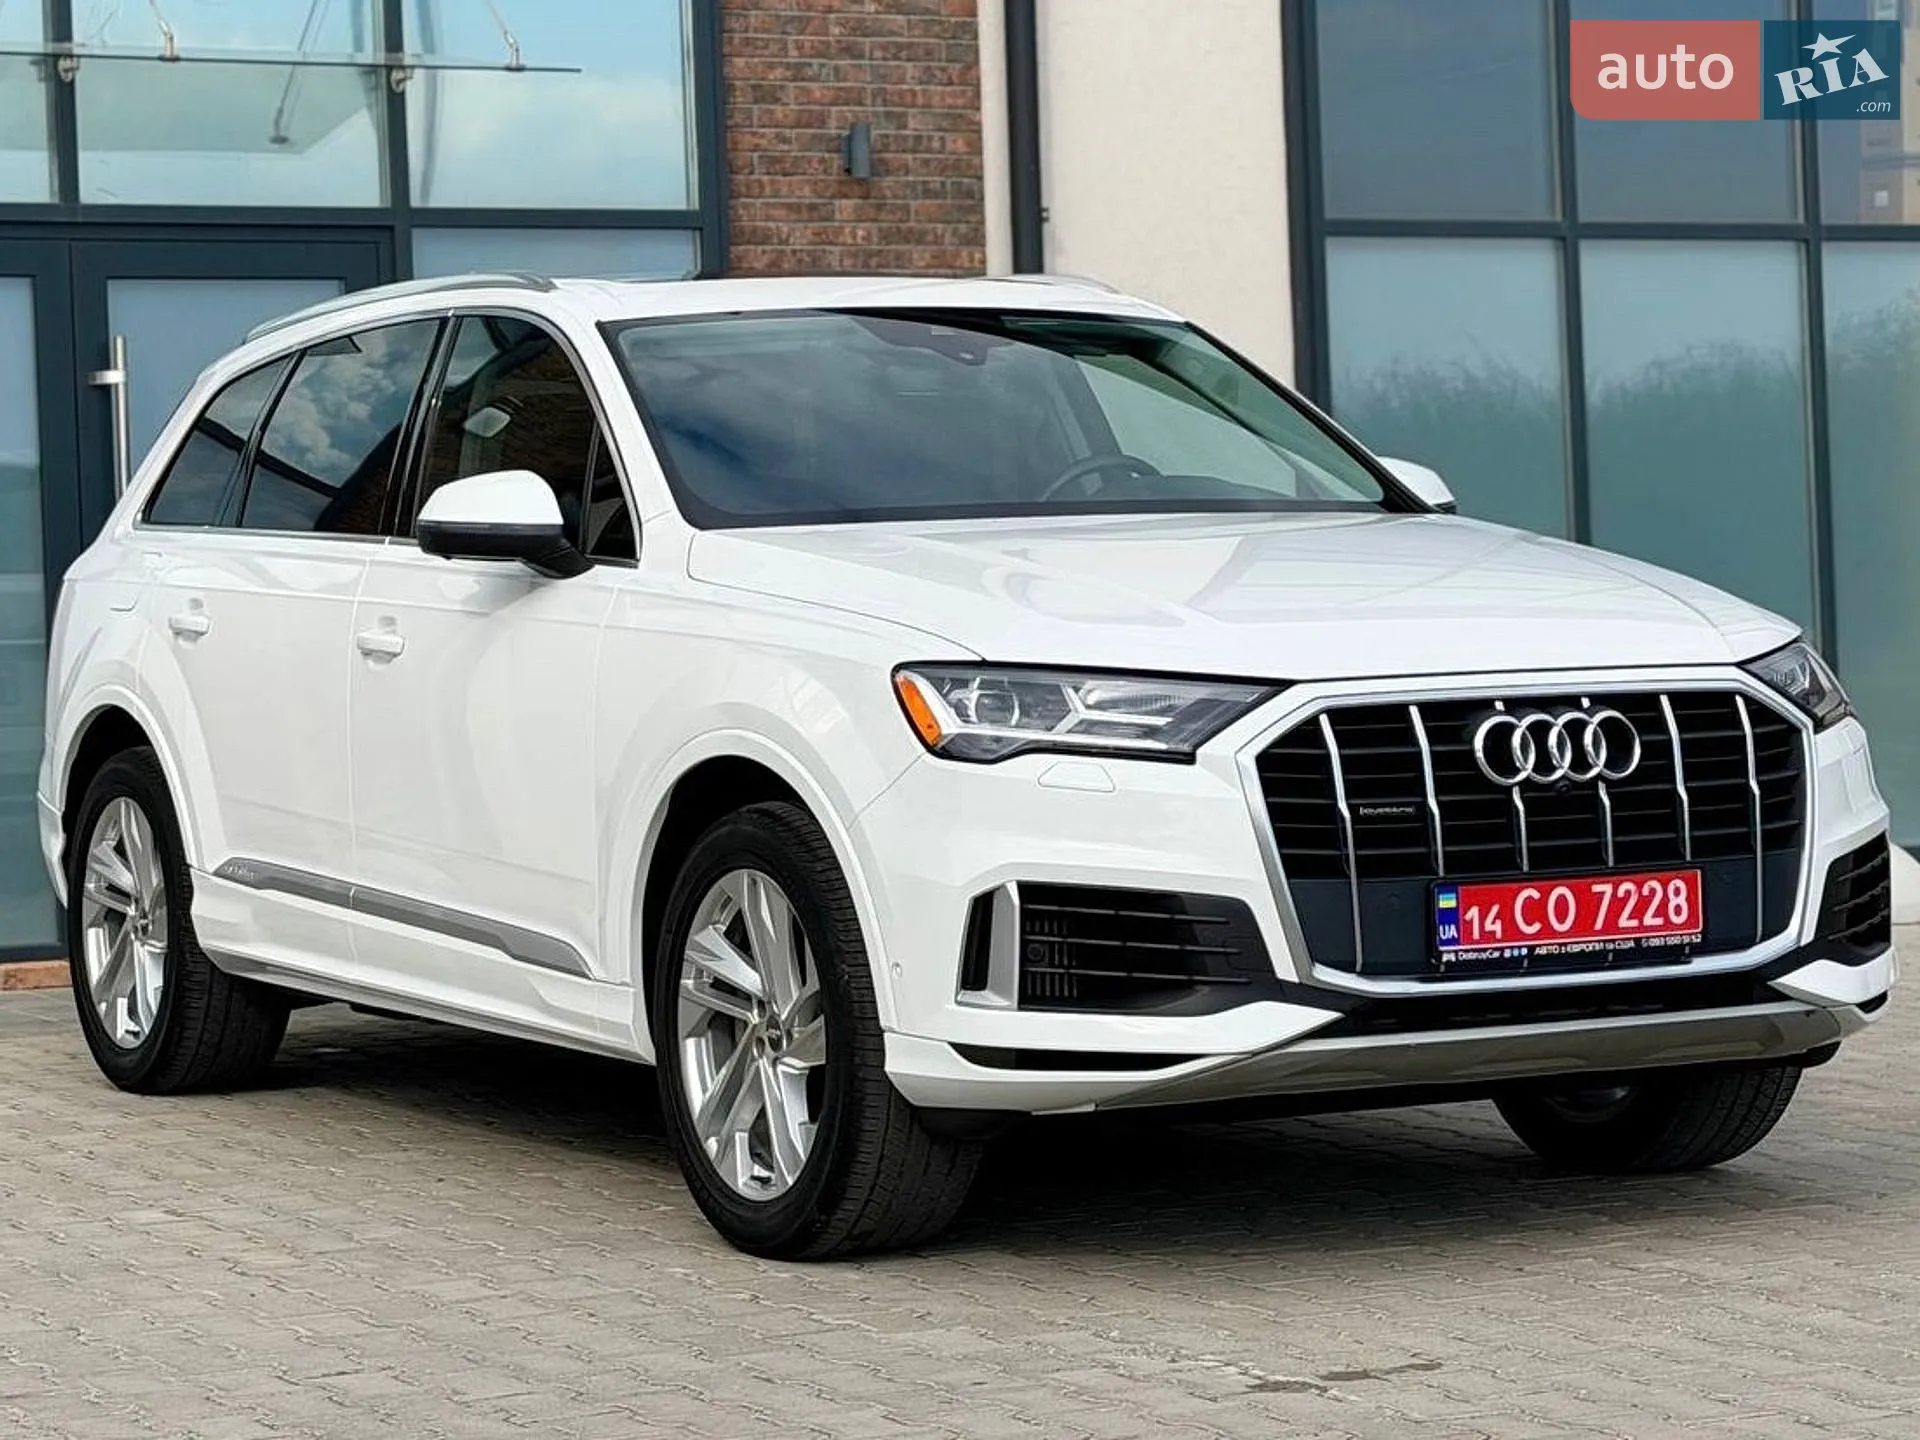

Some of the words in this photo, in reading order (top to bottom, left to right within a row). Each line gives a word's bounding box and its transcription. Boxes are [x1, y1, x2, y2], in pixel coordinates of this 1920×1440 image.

[1464, 904, 1502, 940] 14
[1514, 885, 1576, 935] CO
[1591, 878, 1689, 931] 7228
[1439, 924, 1458, 940] UA
